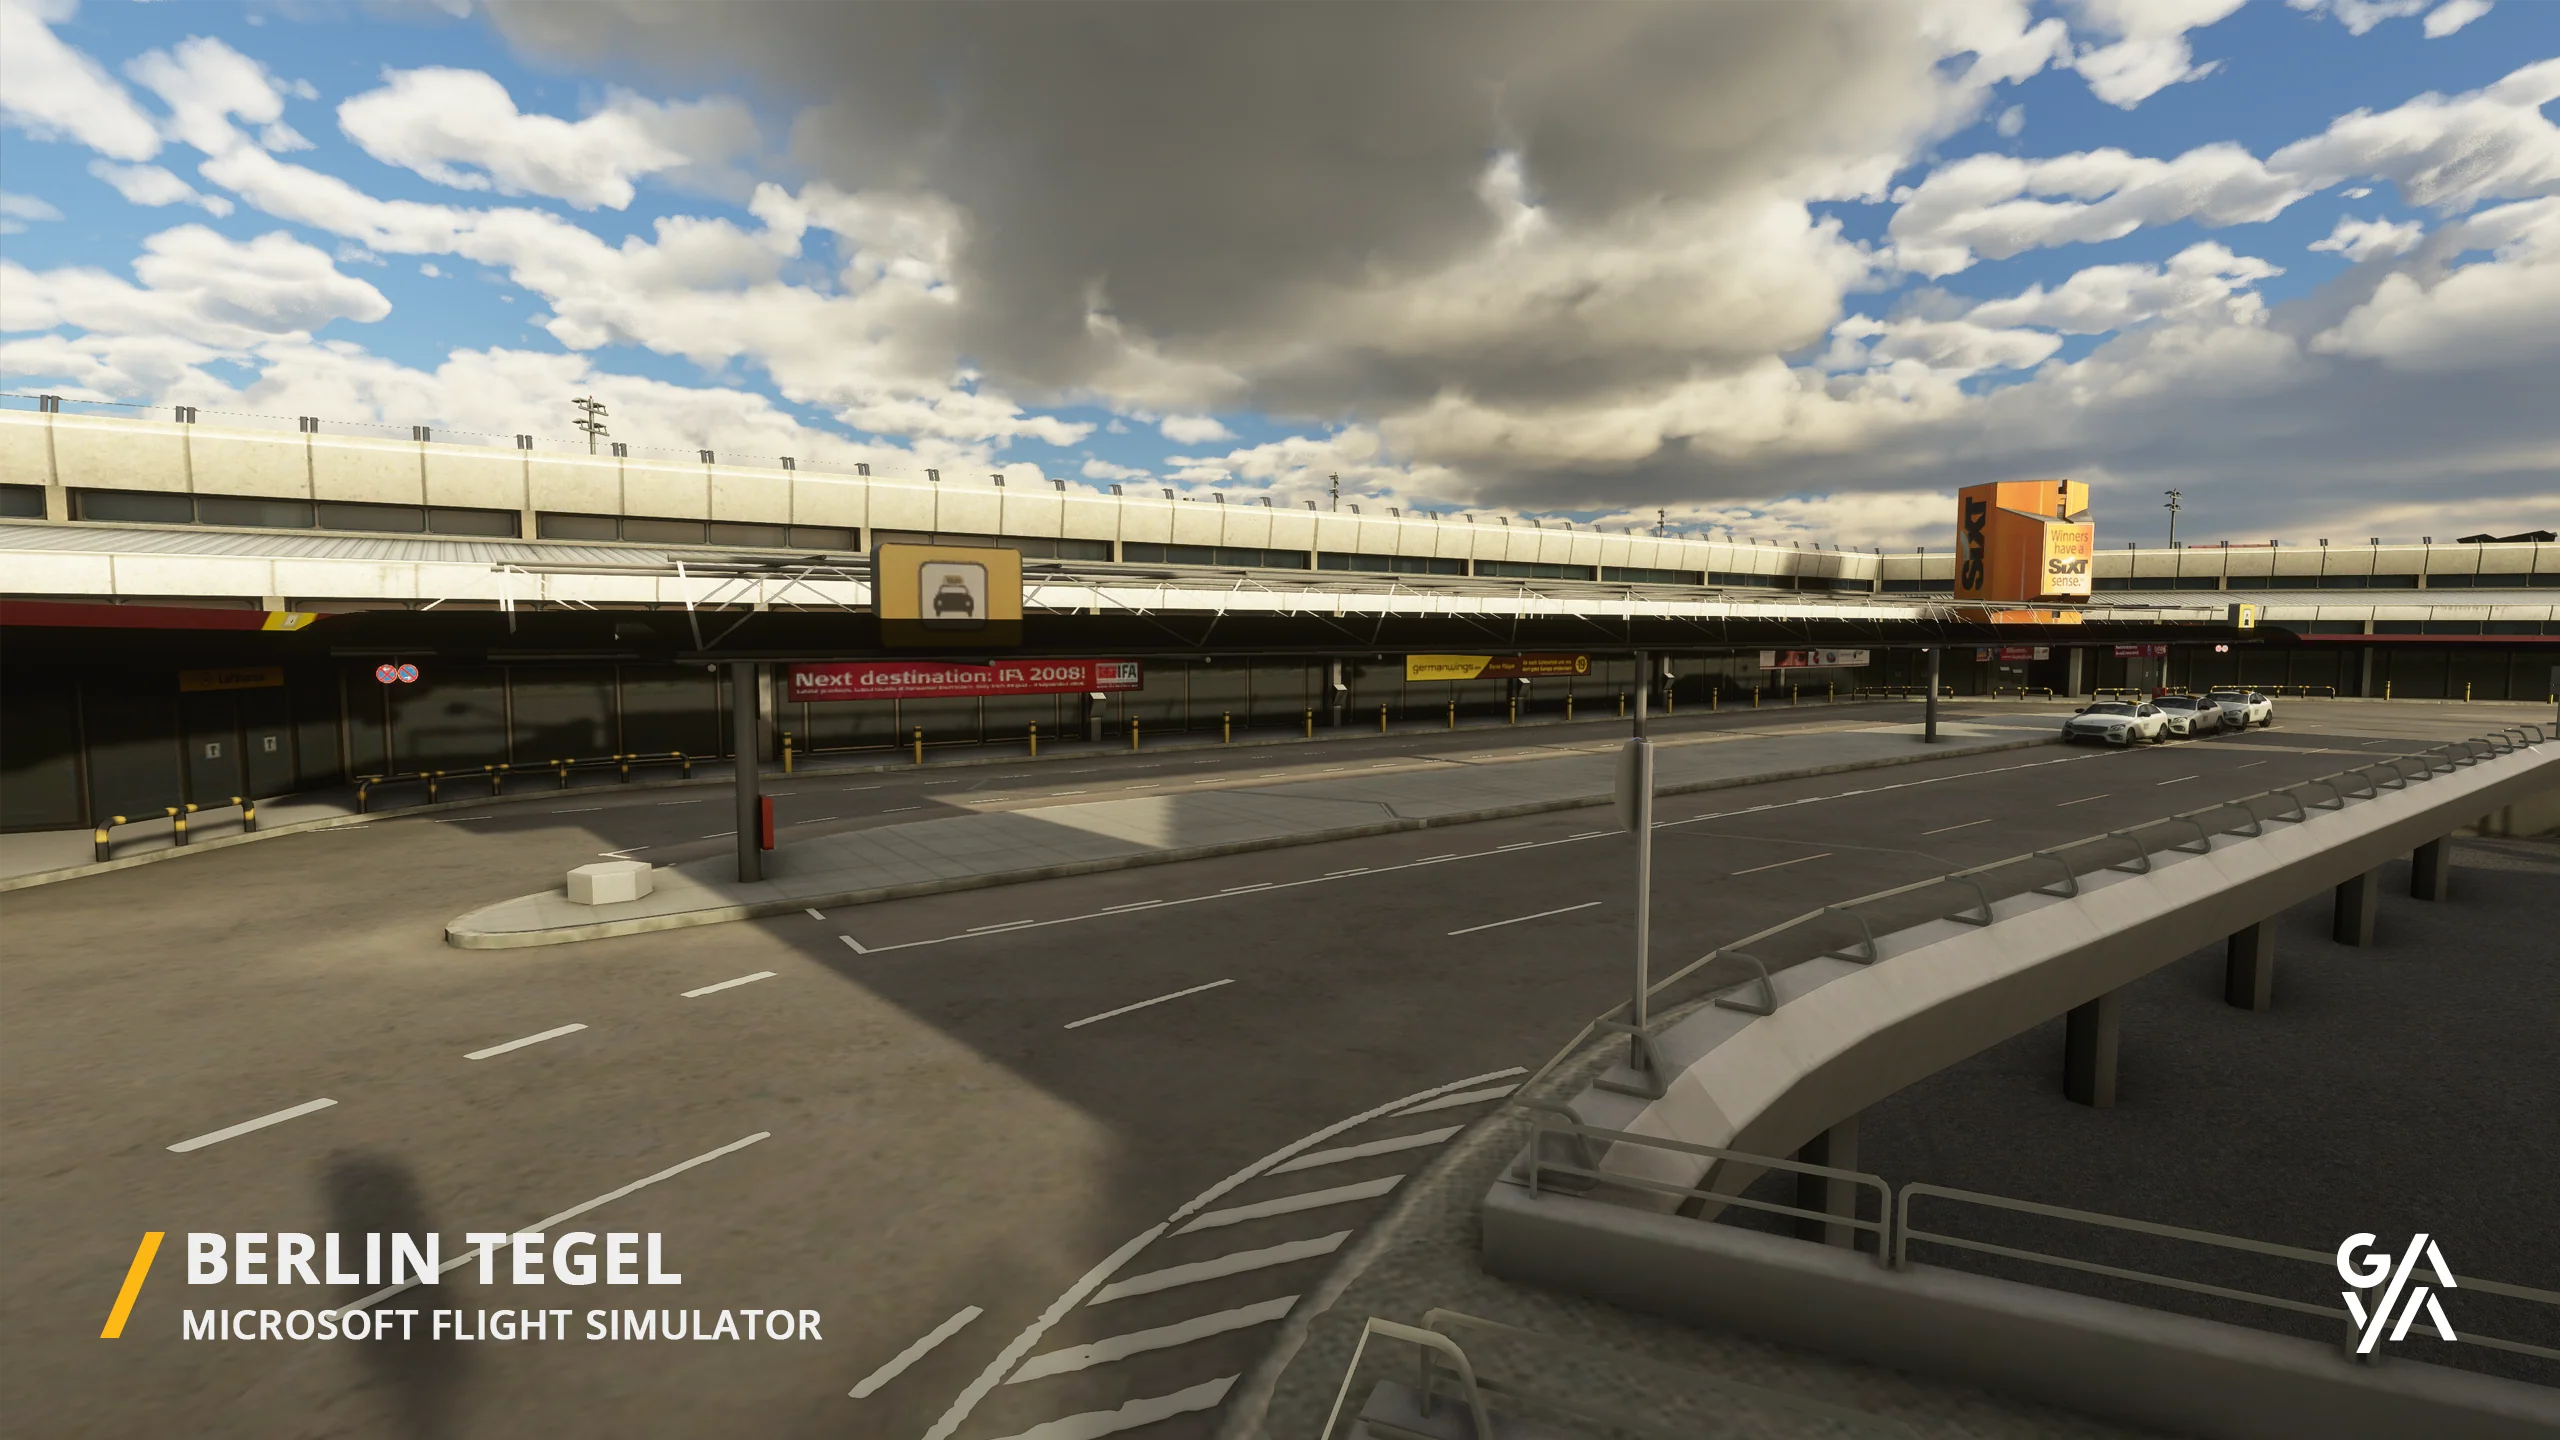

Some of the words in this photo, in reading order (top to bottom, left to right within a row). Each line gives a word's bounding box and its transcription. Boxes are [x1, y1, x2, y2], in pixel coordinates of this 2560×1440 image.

[2051, 529, 2088, 542] Winners
[2054, 542, 2077, 554] have
[2078, 545, 2085, 555] a
[2051, 577, 2081, 587] sense.
[1117, 663, 1138, 679] IFA
[1412, 663, 1474, 675] germanwings
[796, 671, 854, 688] Next
[860, 668, 993, 686] destination:
[999, 668, 1024, 682] IFA
[1029, 666, 1087, 681] 2008!
